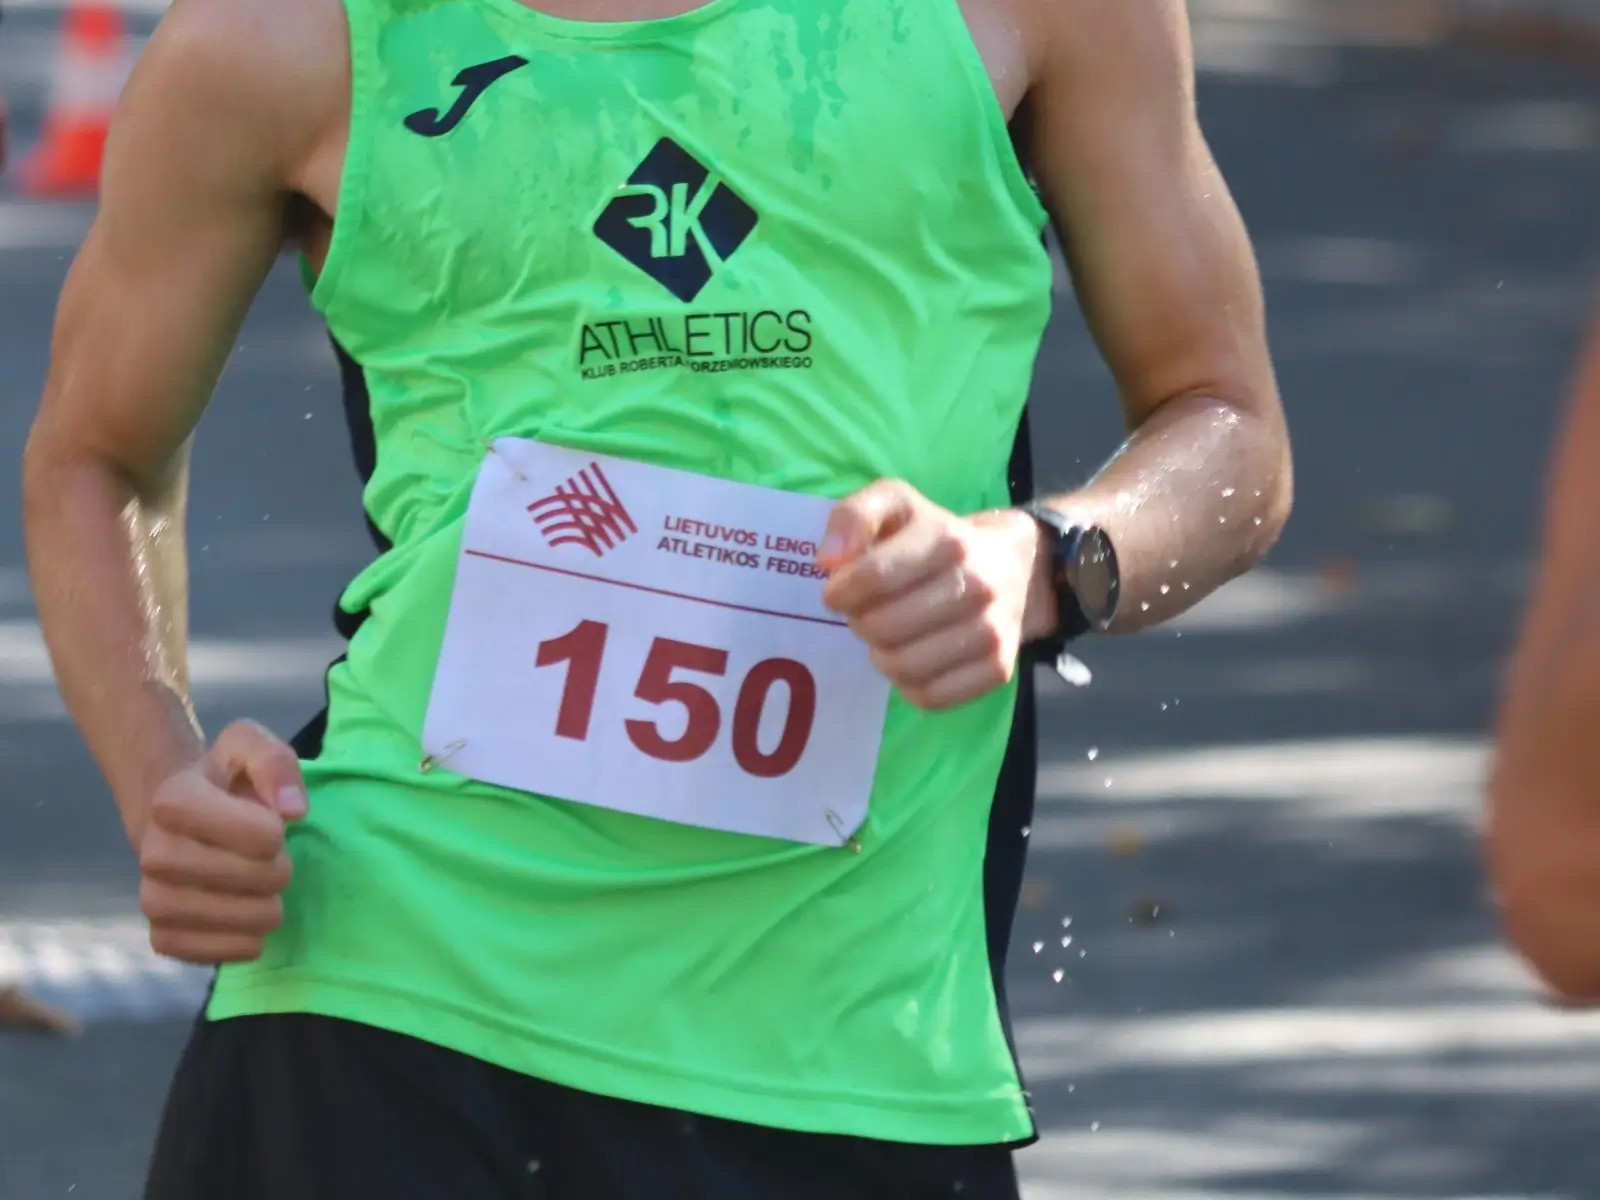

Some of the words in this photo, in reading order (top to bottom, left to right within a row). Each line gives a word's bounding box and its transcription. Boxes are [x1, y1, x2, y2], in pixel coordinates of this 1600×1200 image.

[616, 173, 722, 275] RK
[580, 310, 811, 365] ATHLETICS
[582, 365, 616, 380] KLUB
[620, 356, 684, 373] ROBERTA
[657, 536, 760, 569] ATLETIKOS
[664, 515, 758, 547] LIETUVOS
[535, 619, 816, 778] 150
